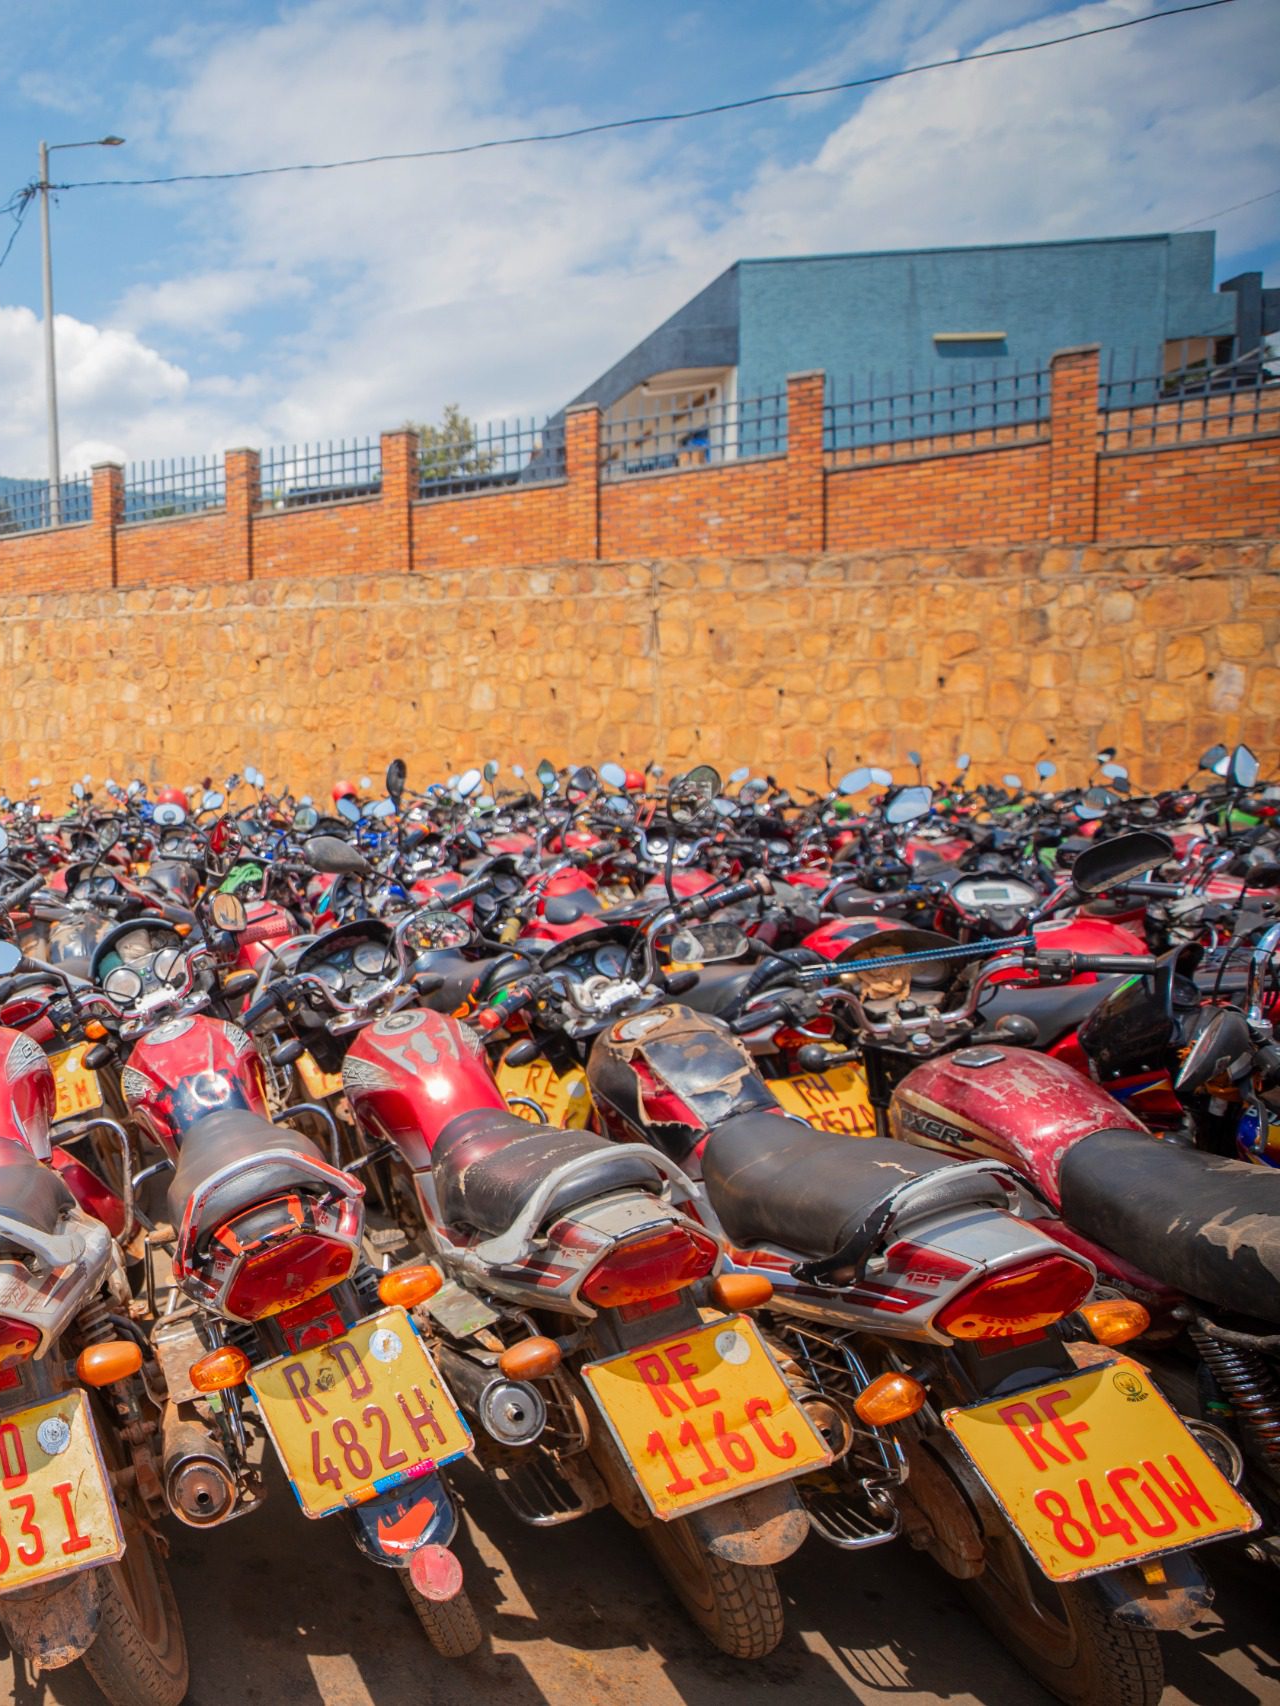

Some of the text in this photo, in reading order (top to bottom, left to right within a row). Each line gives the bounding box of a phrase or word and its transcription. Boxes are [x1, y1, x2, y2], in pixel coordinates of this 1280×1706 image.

[904, 1271, 946, 1288] 125
[633, 1342, 721, 1418] RE
[310, 1385, 447, 1491] 482H
[646, 1397, 797, 1496] 116C
[997, 1389, 1090, 1473] RF
[1033, 1454, 1219, 1559] 840W
